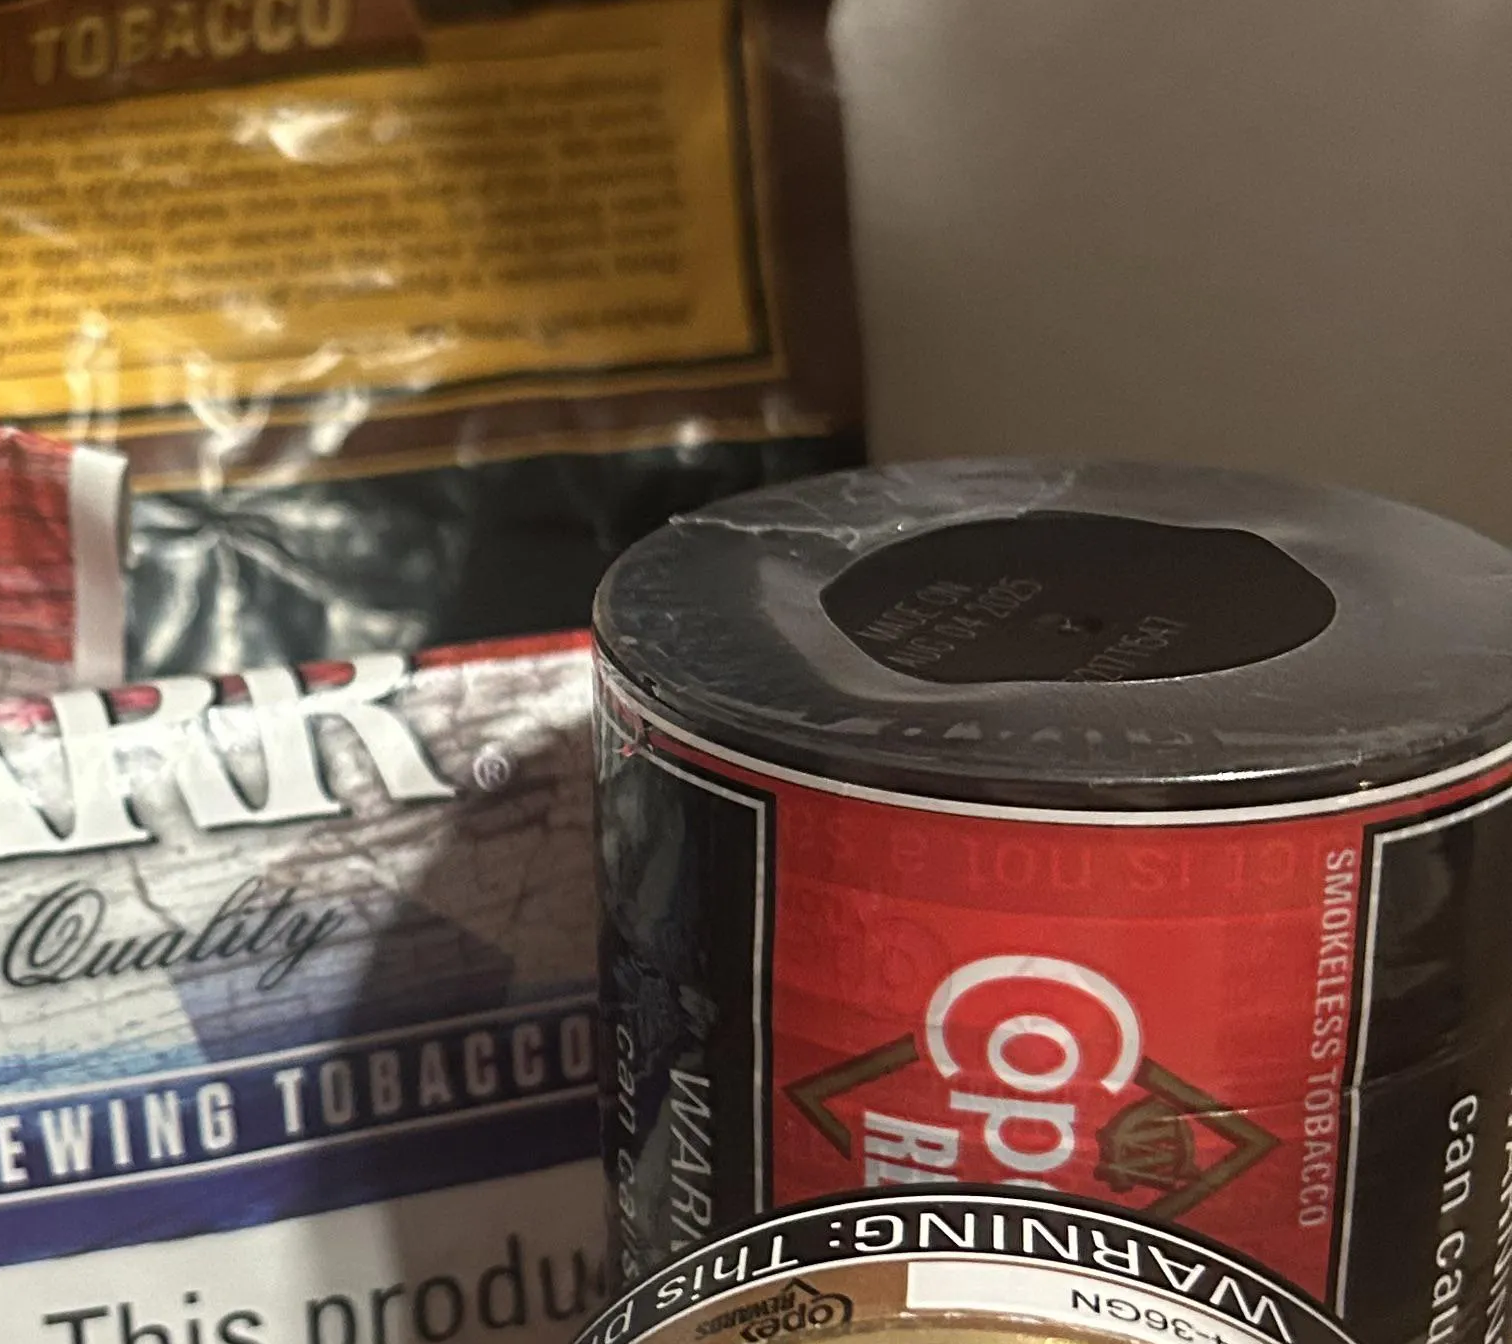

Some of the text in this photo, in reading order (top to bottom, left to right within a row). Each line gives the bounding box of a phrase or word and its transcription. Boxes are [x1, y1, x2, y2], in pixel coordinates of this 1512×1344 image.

[1, 875, 351, 994] Quality
[276, 1016, 593, 1134] TOBACCO
[1297, 847, 1357, 1230] SMOKELESS TOBACCO
[616, 1023, 640, 1282] can caus
[1440, 1092, 1480, 1215] can
[654, 1234, 800, 1310] This
